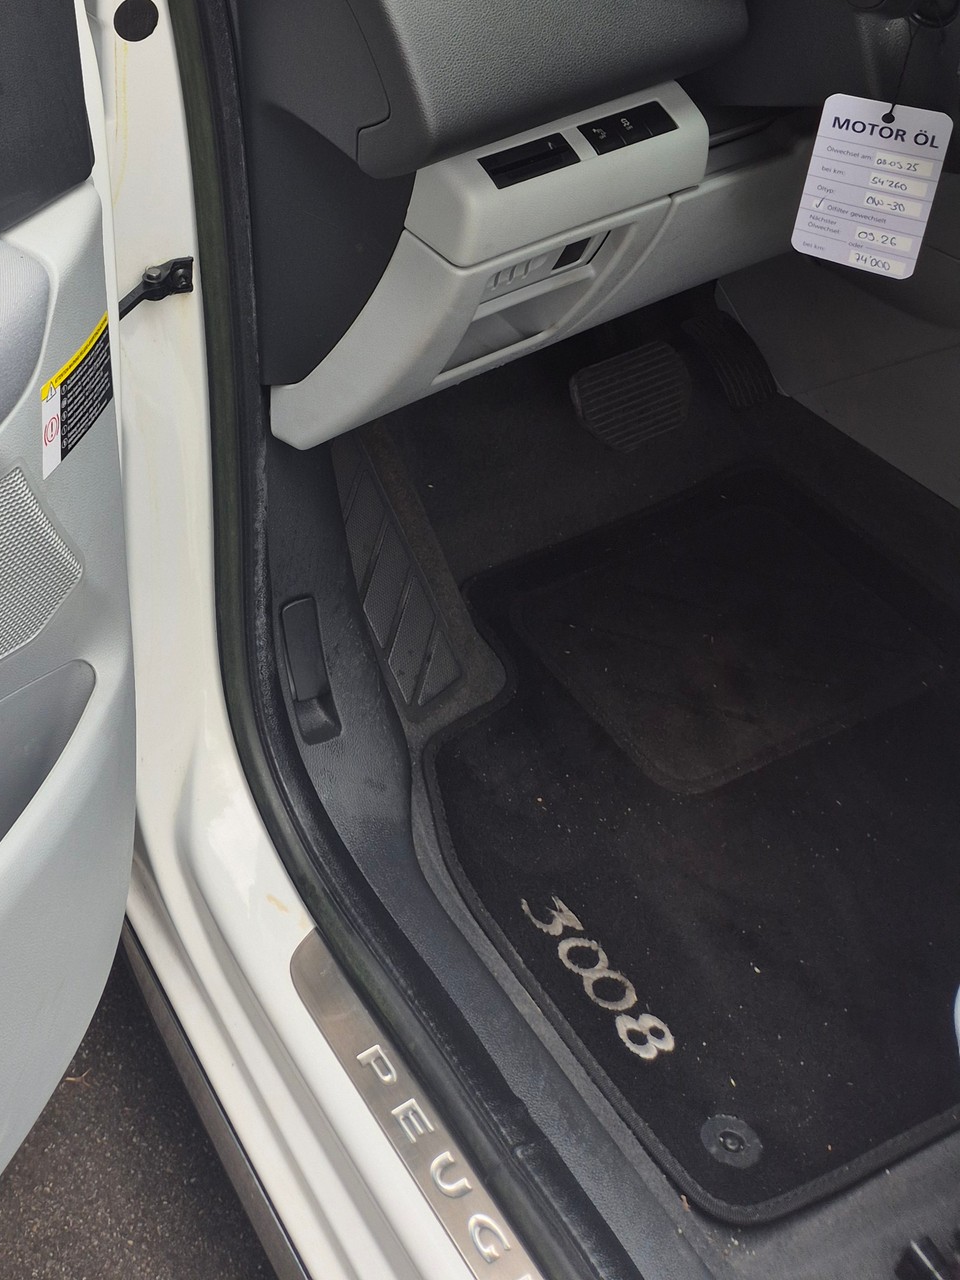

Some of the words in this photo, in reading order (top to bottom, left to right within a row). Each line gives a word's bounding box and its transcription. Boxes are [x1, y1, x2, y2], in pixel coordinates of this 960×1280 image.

[832, 116, 907, 142] MOTOR
[913, 129, 939, 149] ÖL
[826, 145, 860, 158] Ölwechsel
[821, 165, 831, 174] bei
[809, 213, 837, 226] Nächster
[826, 203, 849, 216] Ölfilter
[850, 210, 887, 225] gewechselt
[848, 240, 864, 250] oder
[520, 894, 676, 1061] 3008
[356, 1044, 534, 1280] PEUG
